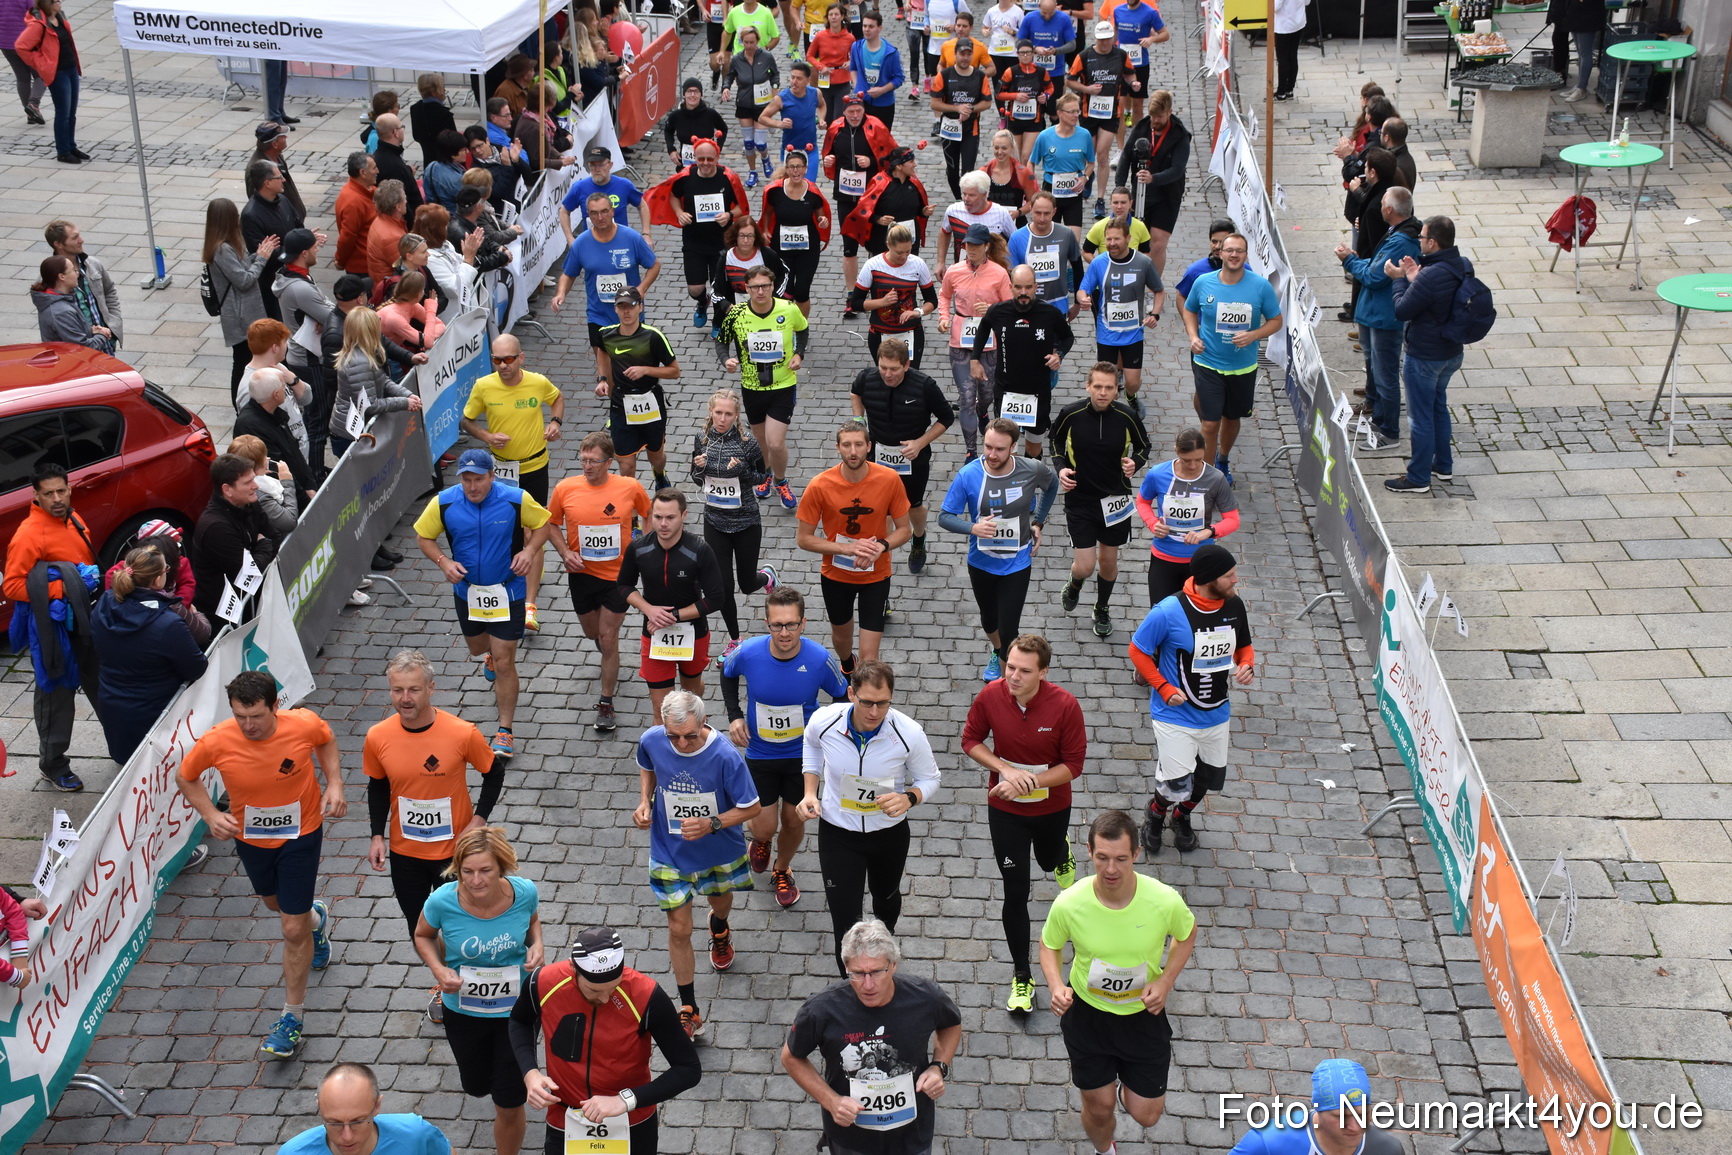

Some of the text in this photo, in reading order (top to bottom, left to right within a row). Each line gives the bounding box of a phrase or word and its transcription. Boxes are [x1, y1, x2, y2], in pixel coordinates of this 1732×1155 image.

[133, 12, 323, 38] BMW ConnectedDrive
[136, 30, 281, 50] Vernetzt, um frei zu sein.
[1093, 102, 1109, 110] 2180
[944, 124, 959, 132] 2228
[843, 177, 861, 187] 2139
[1056, 180, 1075, 188] 2900
[700, 202, 720, 212] 2518
[784, 234, 804, 242] 2155
[1032, 261, 1055, 270] 2208
[601, 282, 622, 293] 2339
[1112, 310, 1134, 320] 2903
[1222, 313, 1246, 323] 2200
[753, 342, 778, 351] 3297
[632, 402, 650, 414] 414
[1006, 403, 1031, 413] 2510
[880, 452, 905, 464] 2002
[709, 484, 736, 496] 2419
[1169, 507, 1198, 519] 2067
[584, 536, 613, 548] 2091
[288, 529, 336, 618] BOCK
[225, 595, 237, 617] swn
[476, 596, 498, 608] 196
[662, 634, 684, 646] 417
[1201, 643, 1230, 657] 2152
[768, 716, 791, 729] 191
[857, 788, 875, 801] 74
[673, 805, 710, 818] 2563
[252, 815, 292, 826] 2068
[407, 811, 441, 826] 2201
[39, 861, 52, 886] swn
[461, 933, 511, 959] Choose
[490, 940, 518, 960] your
[468, 982, 511, 996] 2074
[1101, 978, 1133, 992] 207
[83, 950, 133, 1035] Service-Line:
[1531, 980, 1554, 1028] Neumarkts
[860, 1092, 906, 1111] 2496
[586, 1124, 609, 1138] 26
